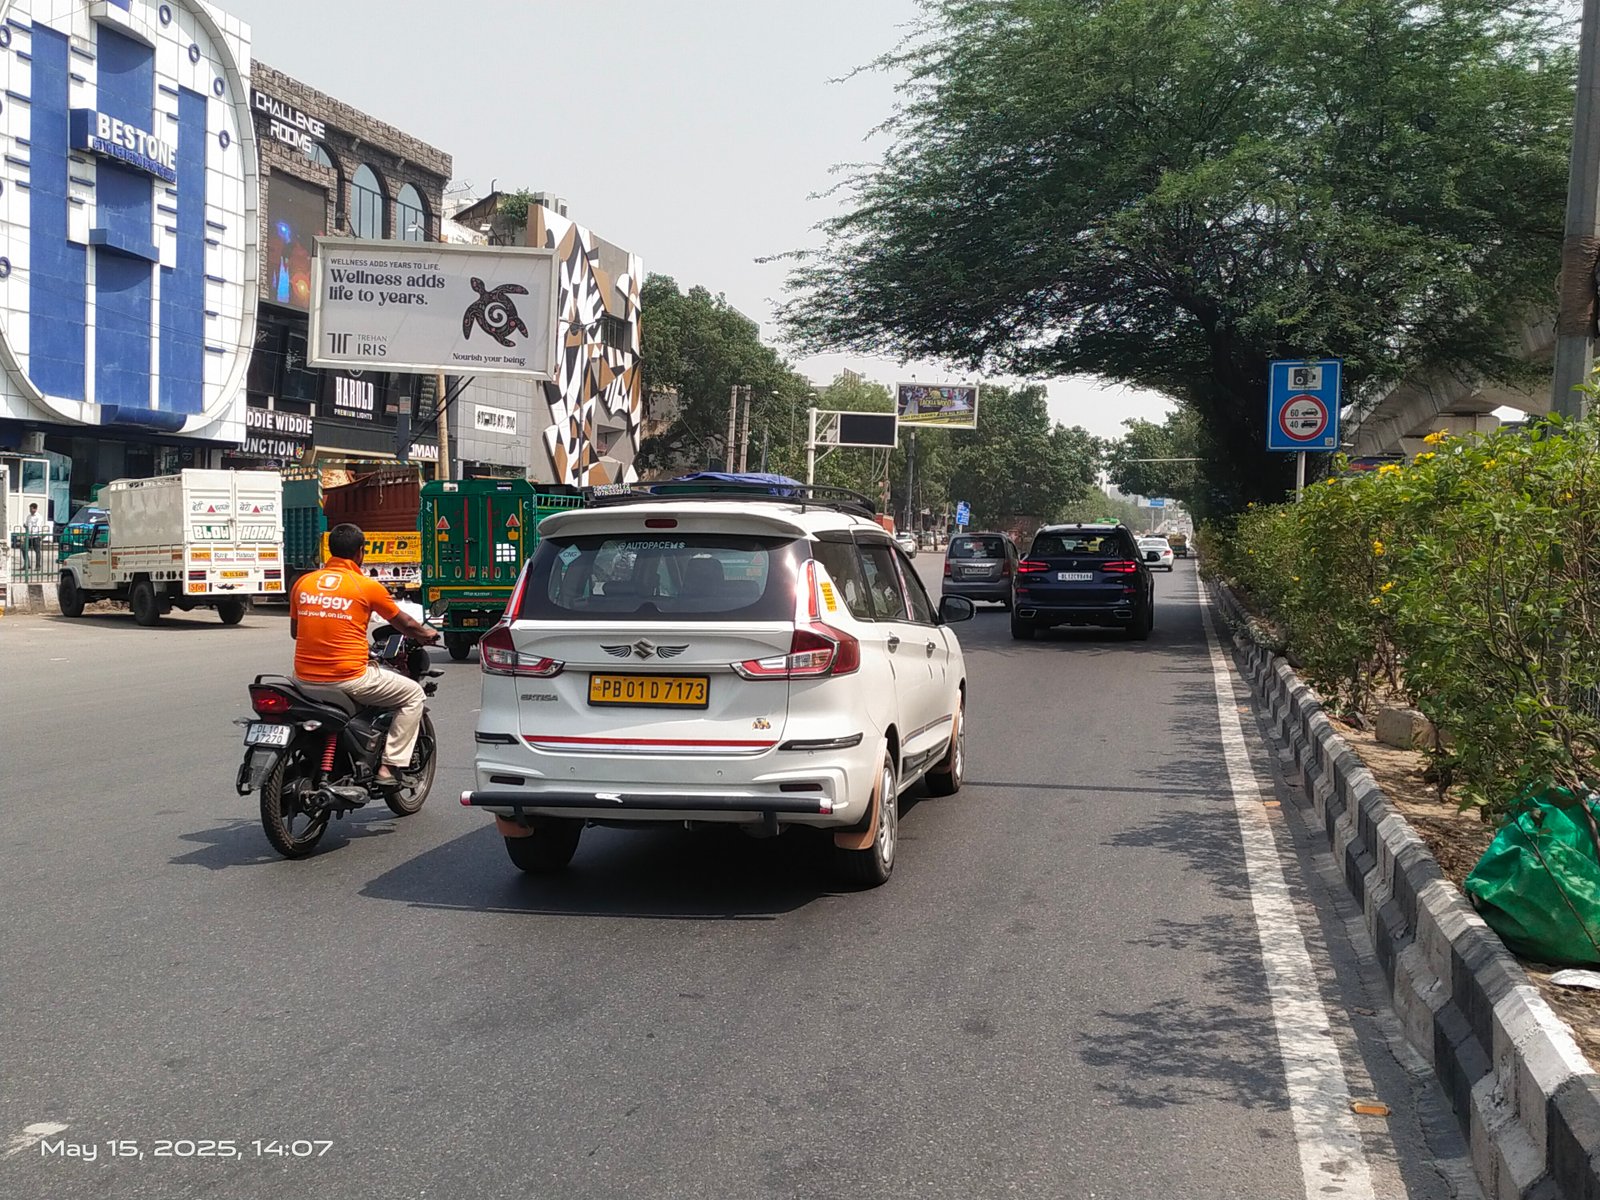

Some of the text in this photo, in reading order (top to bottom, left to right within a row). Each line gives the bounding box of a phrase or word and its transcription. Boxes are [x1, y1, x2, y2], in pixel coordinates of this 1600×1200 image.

[256, 91, 325, 139] CHALLENGE
[98, 112, 176, 171] BESTONE
[271, 119, 312, 153] ROOMS
[331, 258, 440, 271] WELLNESS ADDS YEARS TO LIFE.
[330, 268, 445, 288] Wellness adds
[329, 285, 428, 306] life to years.
[357, 333, 388, 342] TREHAN
[357, 343, 387, 356] IRIS
[453, 352, 527, 367] Nourish your being.
[335, 376, 374, 411] HAROLD
[247, 411, 313, 434] DDIE WIDDIE
[334, 408, 373, 420] PREMIUM LIGHTS
[1290, 409, 1299, 417] 60
[1290, 420, 1299, 428] 40
[193, 525, 276, 540] BLOW HORN
[300, 592, 353, 611] Swiggy
[603, 680, 704, 700] PB 01 D 7173
